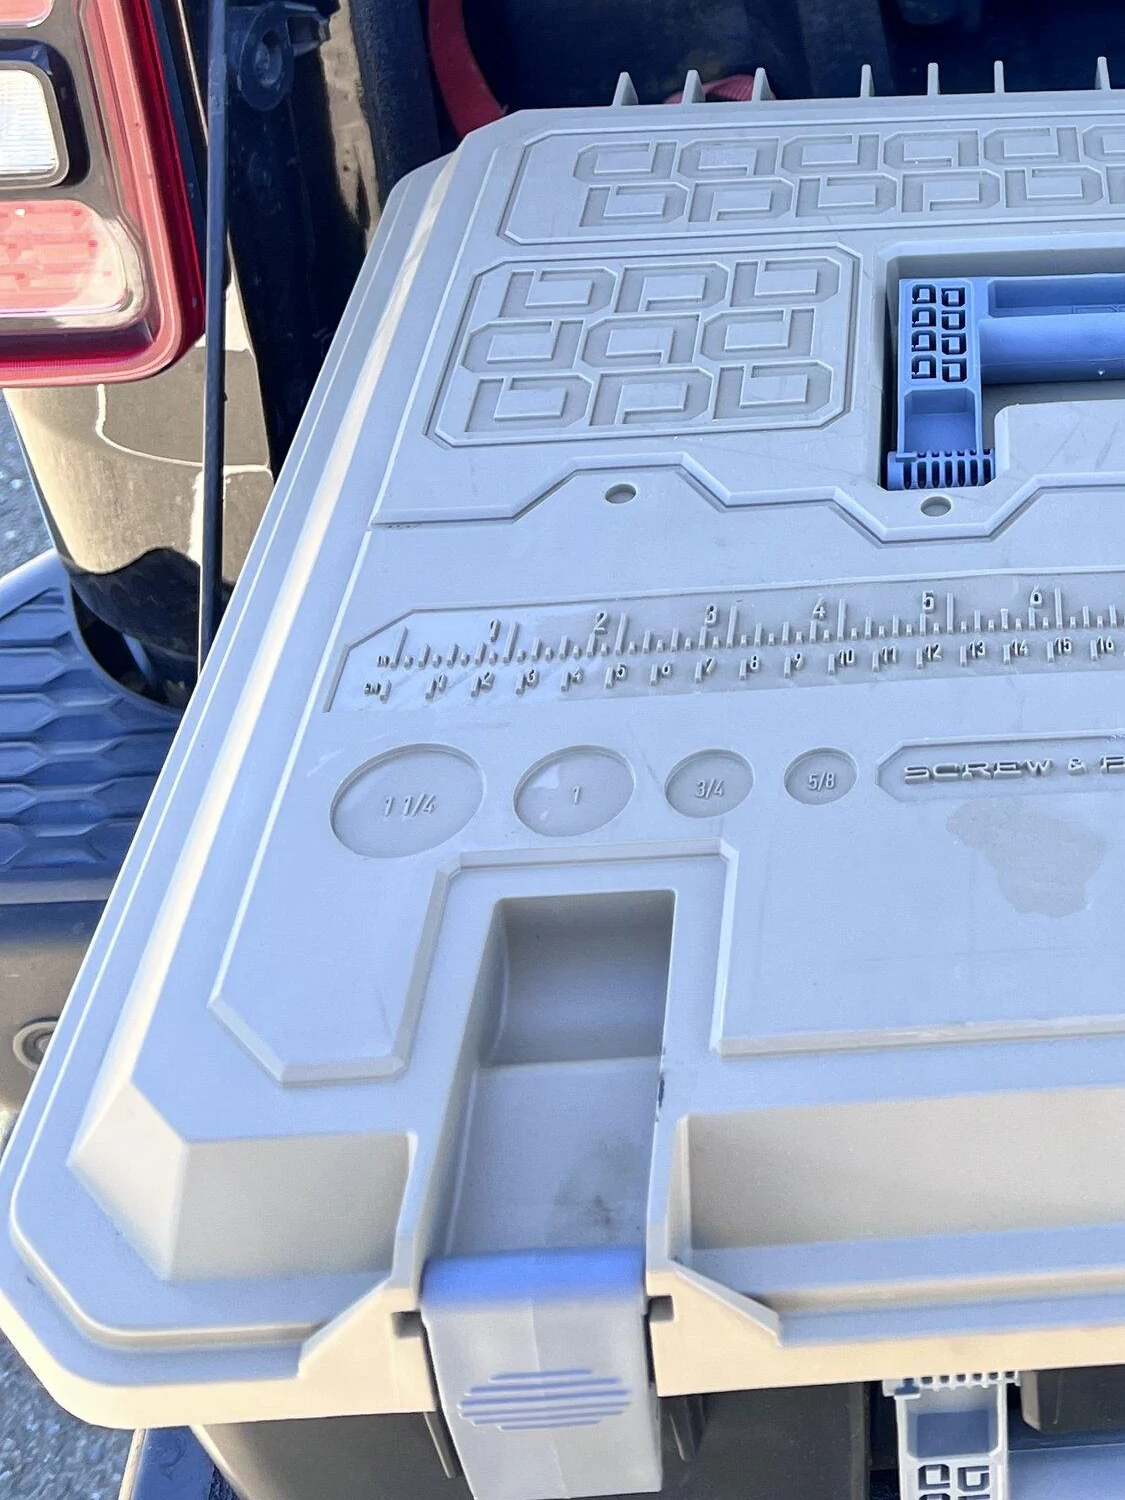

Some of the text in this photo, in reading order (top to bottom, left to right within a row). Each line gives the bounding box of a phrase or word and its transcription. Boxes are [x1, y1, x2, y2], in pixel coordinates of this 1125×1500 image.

[490, 619, 501, 642] 1
[594, 610, 609, 634] 2
[705, 604, 718, 627] 3
[812, 597, 825, 620] 4
[922, 590, 935, 613] 5
[1030, 585, 1043, 608] 6
[437, 671, 448, 692] 1
[481, 671, 495, 690] 2
[526, 667, 540, 688] 3
[573, 666, 584, 684] 4
[616, 662, 628, 681] 5
[662, 660, 672, 677] 6
[705, 657, 716, 676] 7
[750, 654, 760, 672] 8
[794, 652, 803, 670] 9
[839, 648, 855, 667] 10
[881, 645, 897, 664] 11
[925, 642, 943, 662] 12
[969, 640, 986, 659] 13
[1011, 638, 1029, 657] 14
[1055, 636, 1073, 655] 15
[1098, 635, 1115, 653] 16
[808, 772, 836, 791] 5/8
[903, 757, 1054, 784] SCREW
[1067, 757, 1088, 776] &
[572, 786, 581, 804] 1
[696, 778, 724, 799] 3/4
[384, 793, 437, 817] 1 1/4
